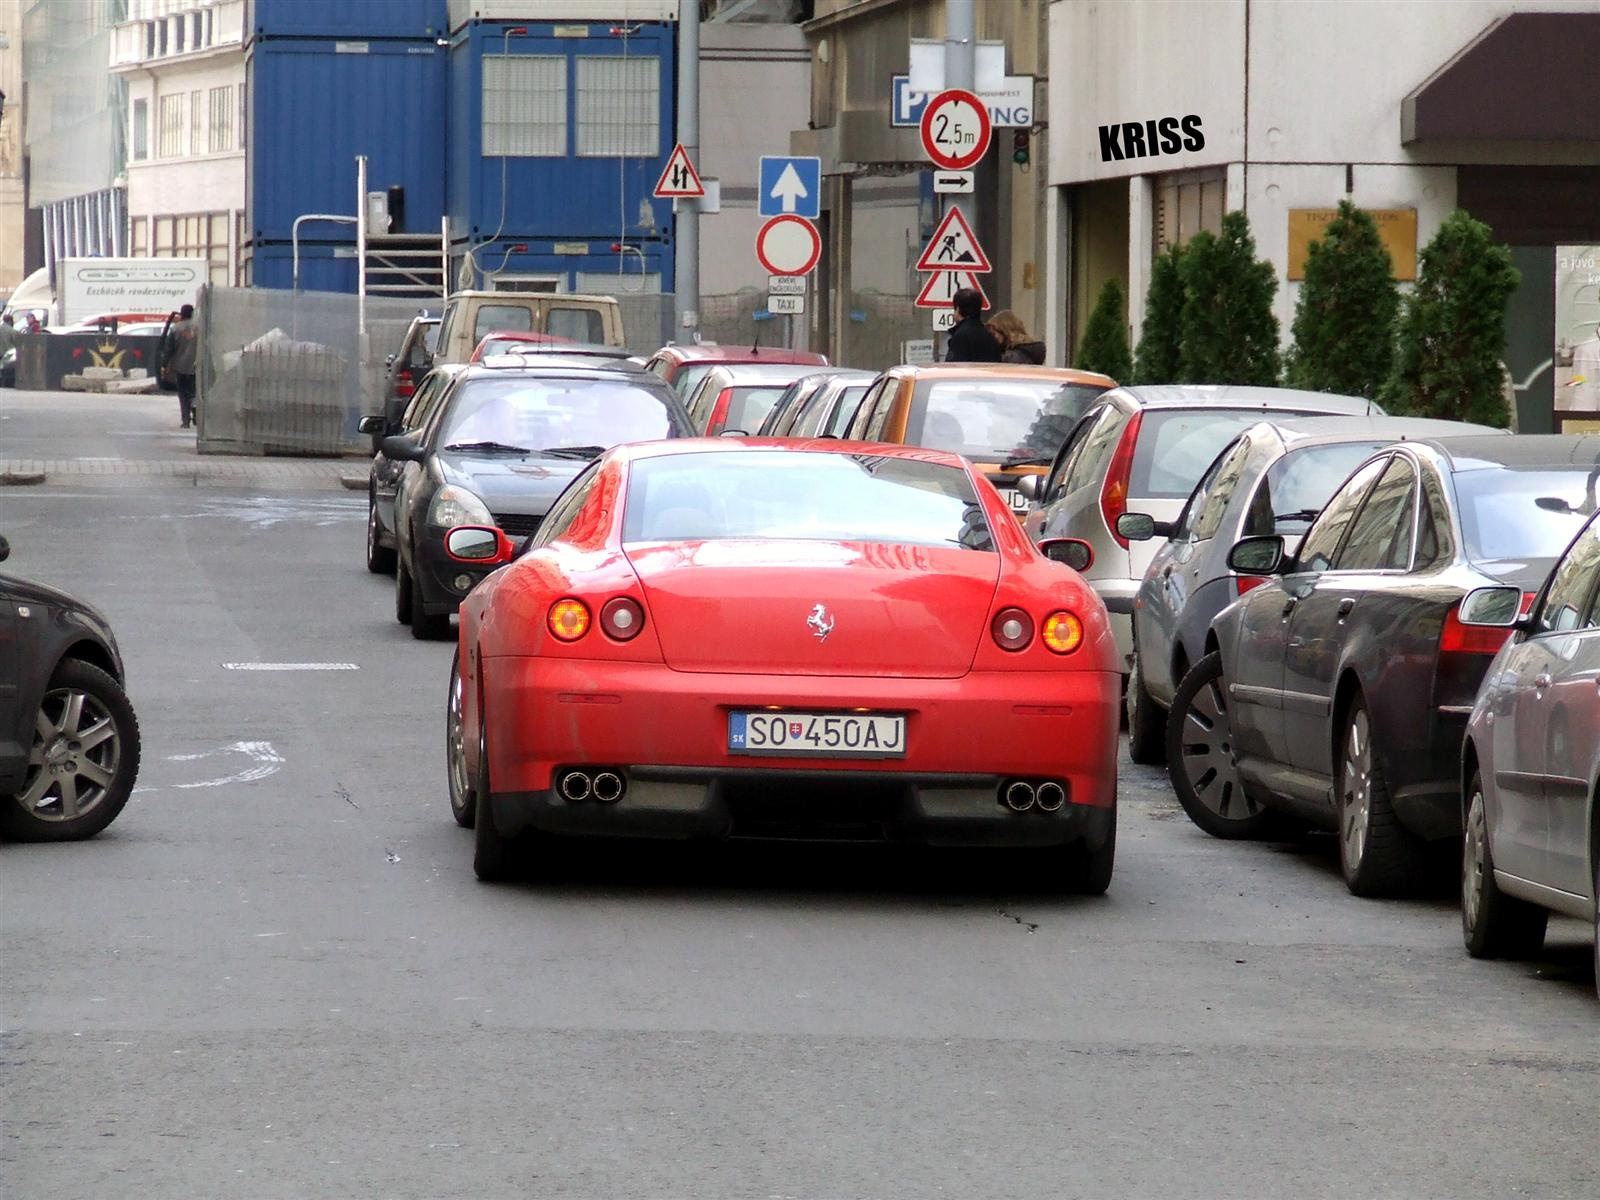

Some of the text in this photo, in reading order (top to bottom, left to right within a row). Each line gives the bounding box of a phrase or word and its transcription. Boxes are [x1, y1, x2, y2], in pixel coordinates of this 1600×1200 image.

[988, 106, 1030, 124] ING
[777, 299, 796, 310] TAXI
[938, 313, 955, 326] 40
[732, 733, 744, 744] SK
[750, 716, 900, 748] SO 450AJ
